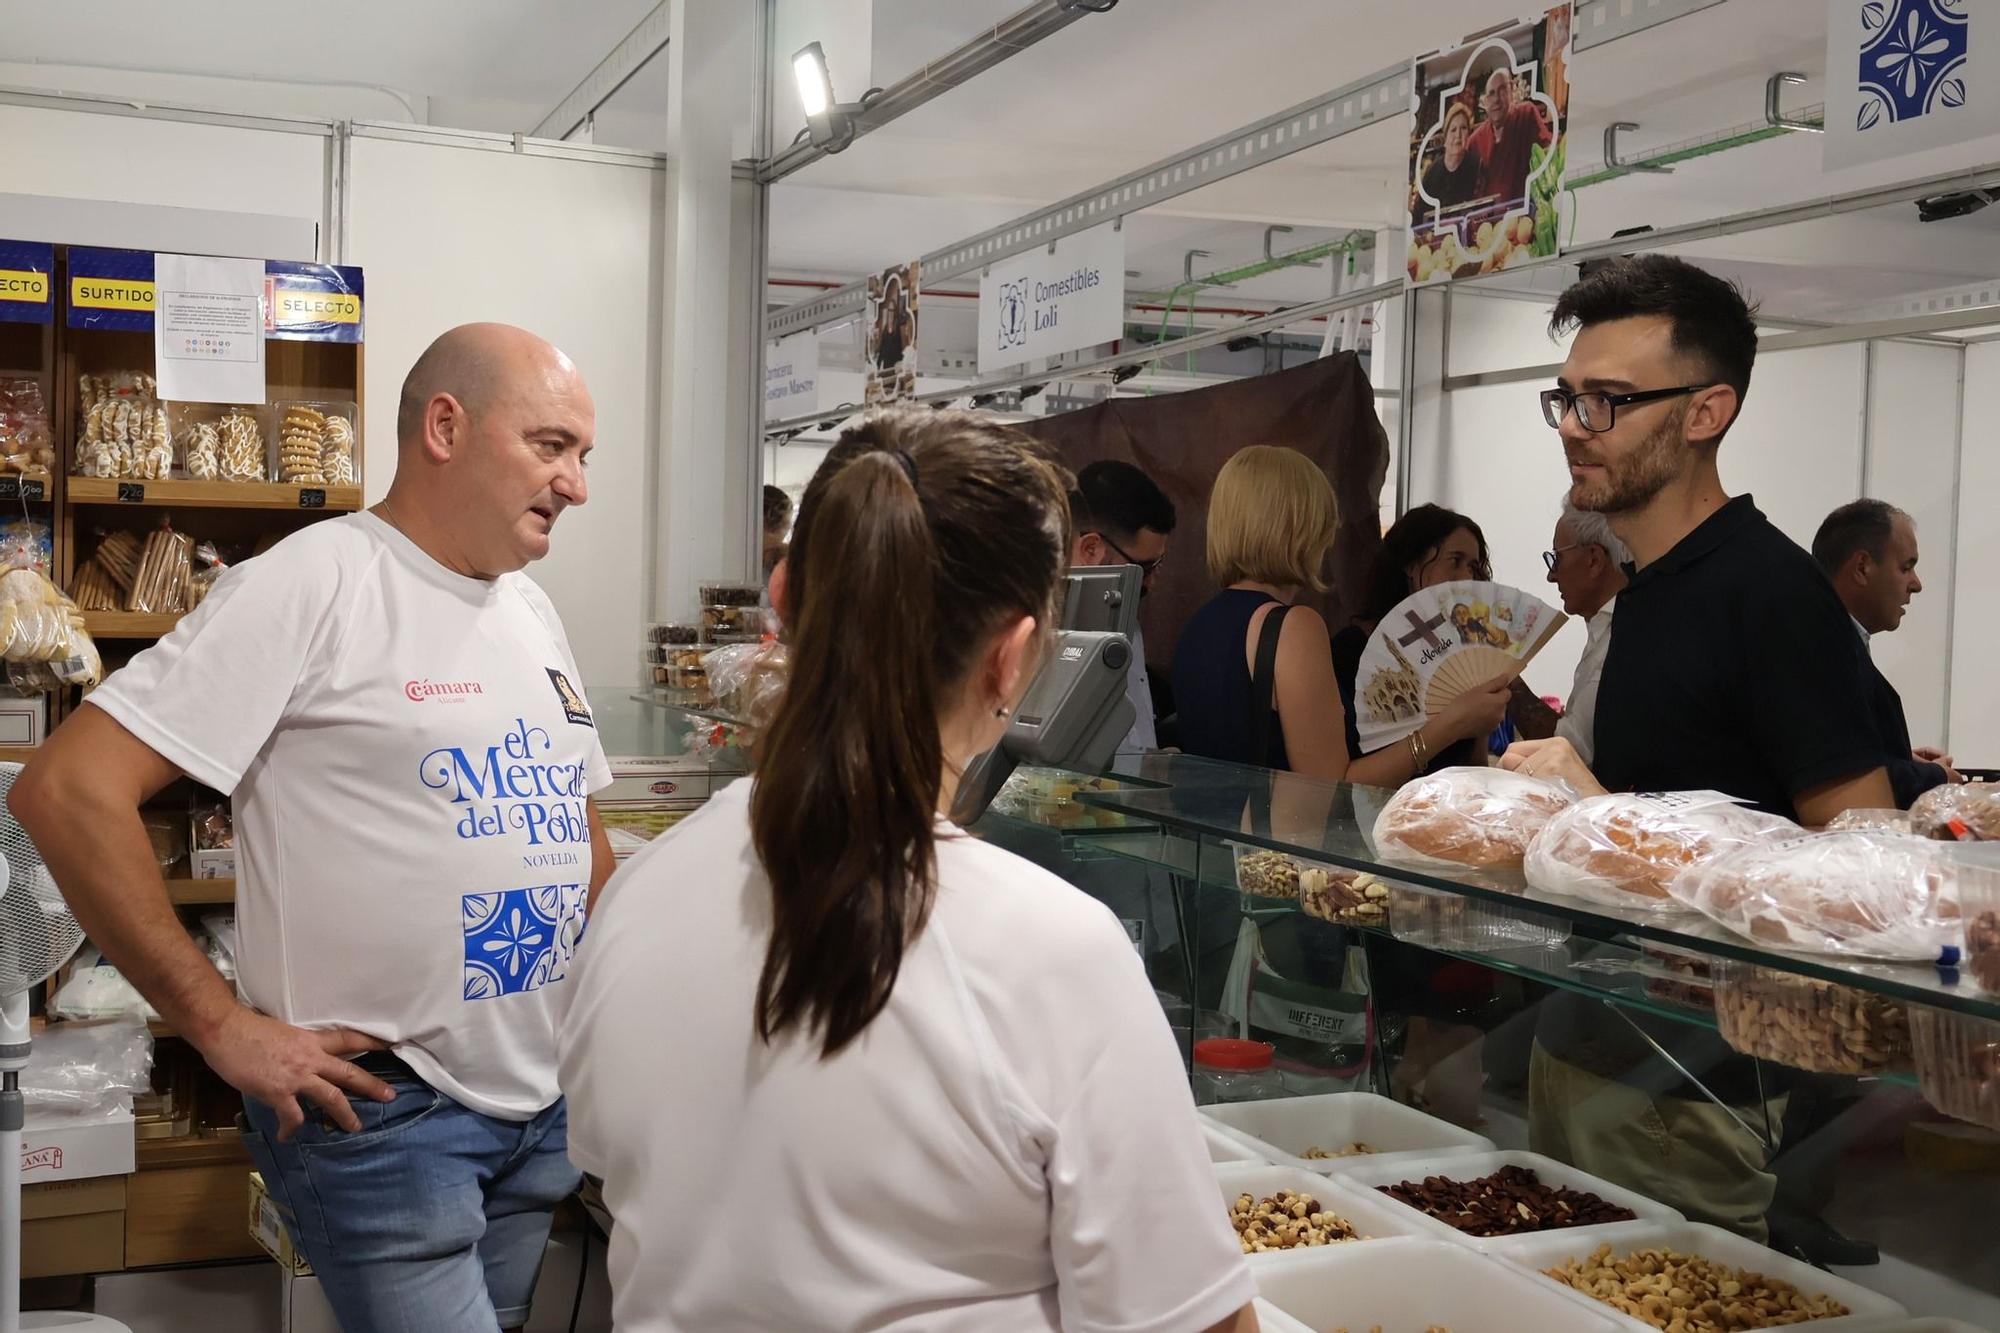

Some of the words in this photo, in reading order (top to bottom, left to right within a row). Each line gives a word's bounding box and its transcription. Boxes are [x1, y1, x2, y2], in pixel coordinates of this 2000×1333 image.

[80, 286, 154, 302] SURTIDO
[1035, 266, 1099, 303] Comestibles
[283, 299, 355, 315] SELECTO
[1034, 304, 1058, 332] Loli
[405, 678, 483, 702] Cámara
[504, 718, 551, 760] el
[456, 806, 507, 839] del
[523, 852, 579, 870] NOVELDA
